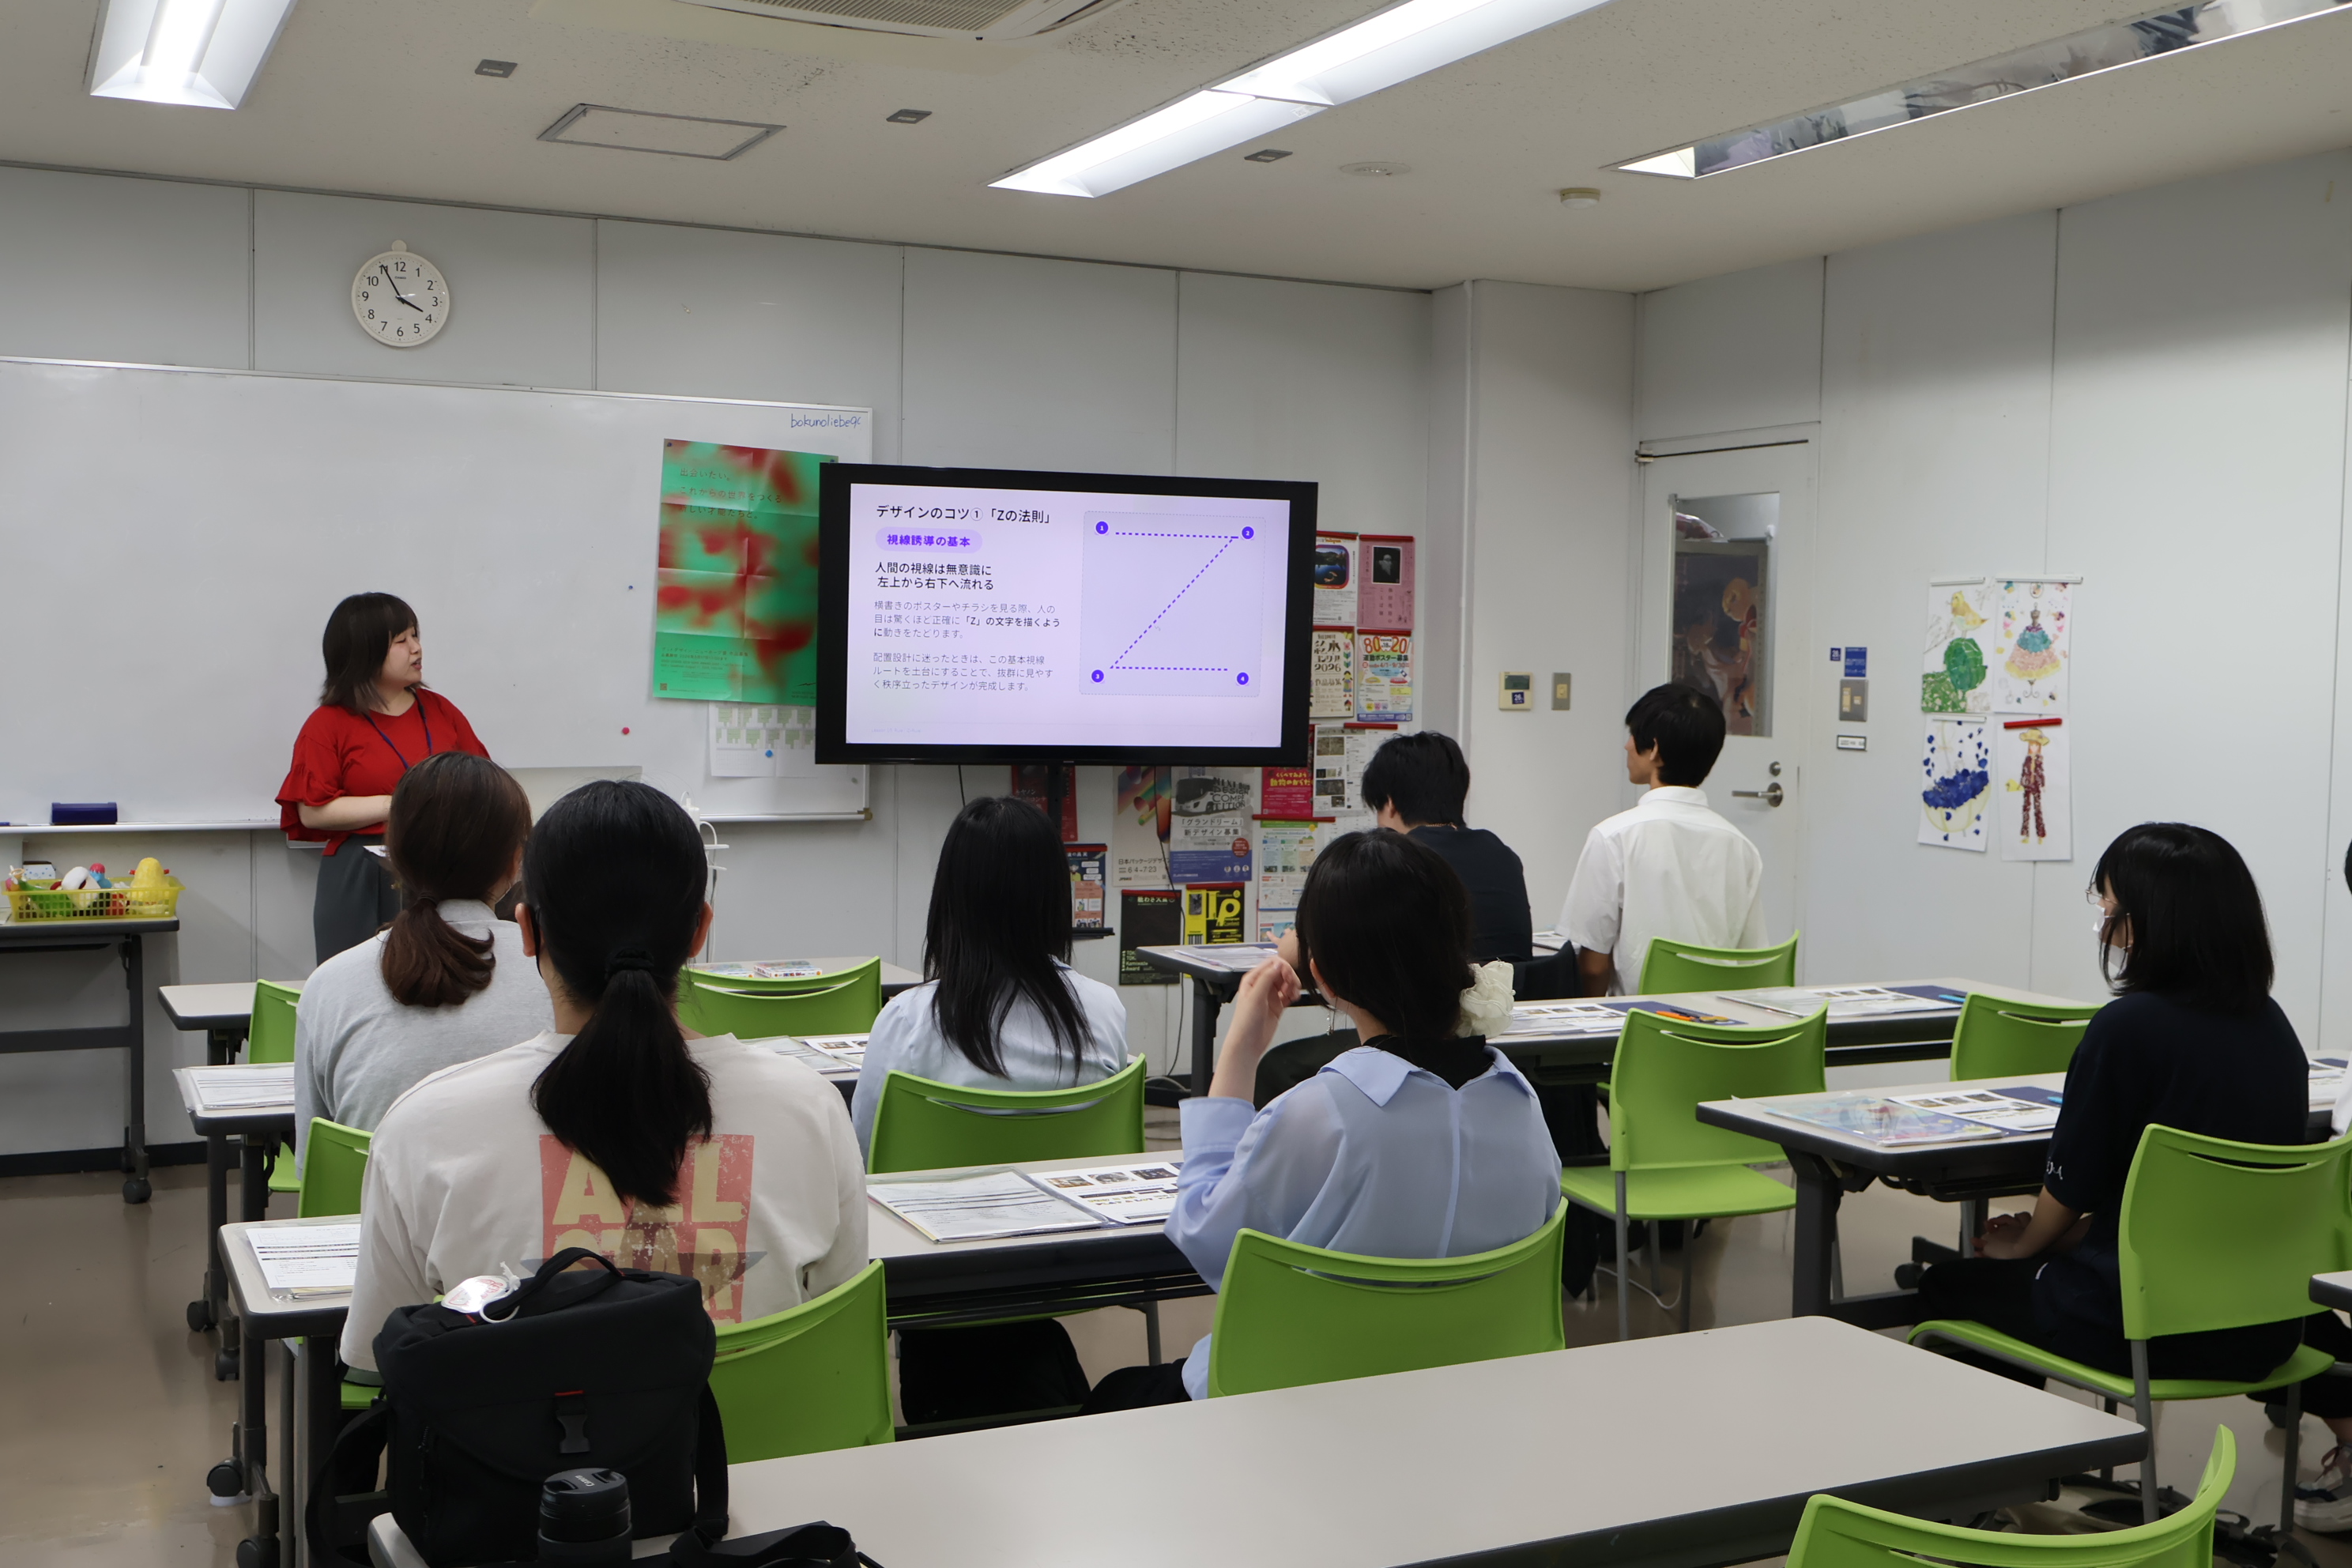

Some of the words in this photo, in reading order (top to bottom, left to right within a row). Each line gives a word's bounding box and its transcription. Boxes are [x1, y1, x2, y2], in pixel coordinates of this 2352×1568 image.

[394, 261, 406, 272] 12
[415, 267, 420, 277] 1
[367, 276, 379, 286] 10
[427, 280, 434, 291] 2
[362, 291, 369, 301] 9
[432, 296, 439, 307] 3
[368, 309, 375, 319] 8
[425, 314, 432, 323] 4
[380, 321, 388, 331] 7
[397, 326, 404, 337] 6
[413, 323, 420, 334] 5
[680, 468, 730, 481] 出会いたい。
[680, 486, 782, 503] これからの世界をつくる
[886, 533, 971, 548] 視線誘導の基本
[875, 561, 992, 575] 人間の視線は無意識に
[877, 576, 994, 590] 左上から右下へ流れる
[873, 600, 1056, 614] 横書きのポスターやチラシを見る際、人の
[873, 628, 963, 639] に動きをたどります。
[873, 652, 1046, 665] 配置設計に迷ったときは、この基本視線
[873, 666, 1054, 679] ルートを土台にすることで、抜群に見やす
[1314, 664, 1341, 673] 2026
[873, 680, 1029, 691] く秩序立ったデザインが完成します。
[552, 1142, 744, 1225] AL
